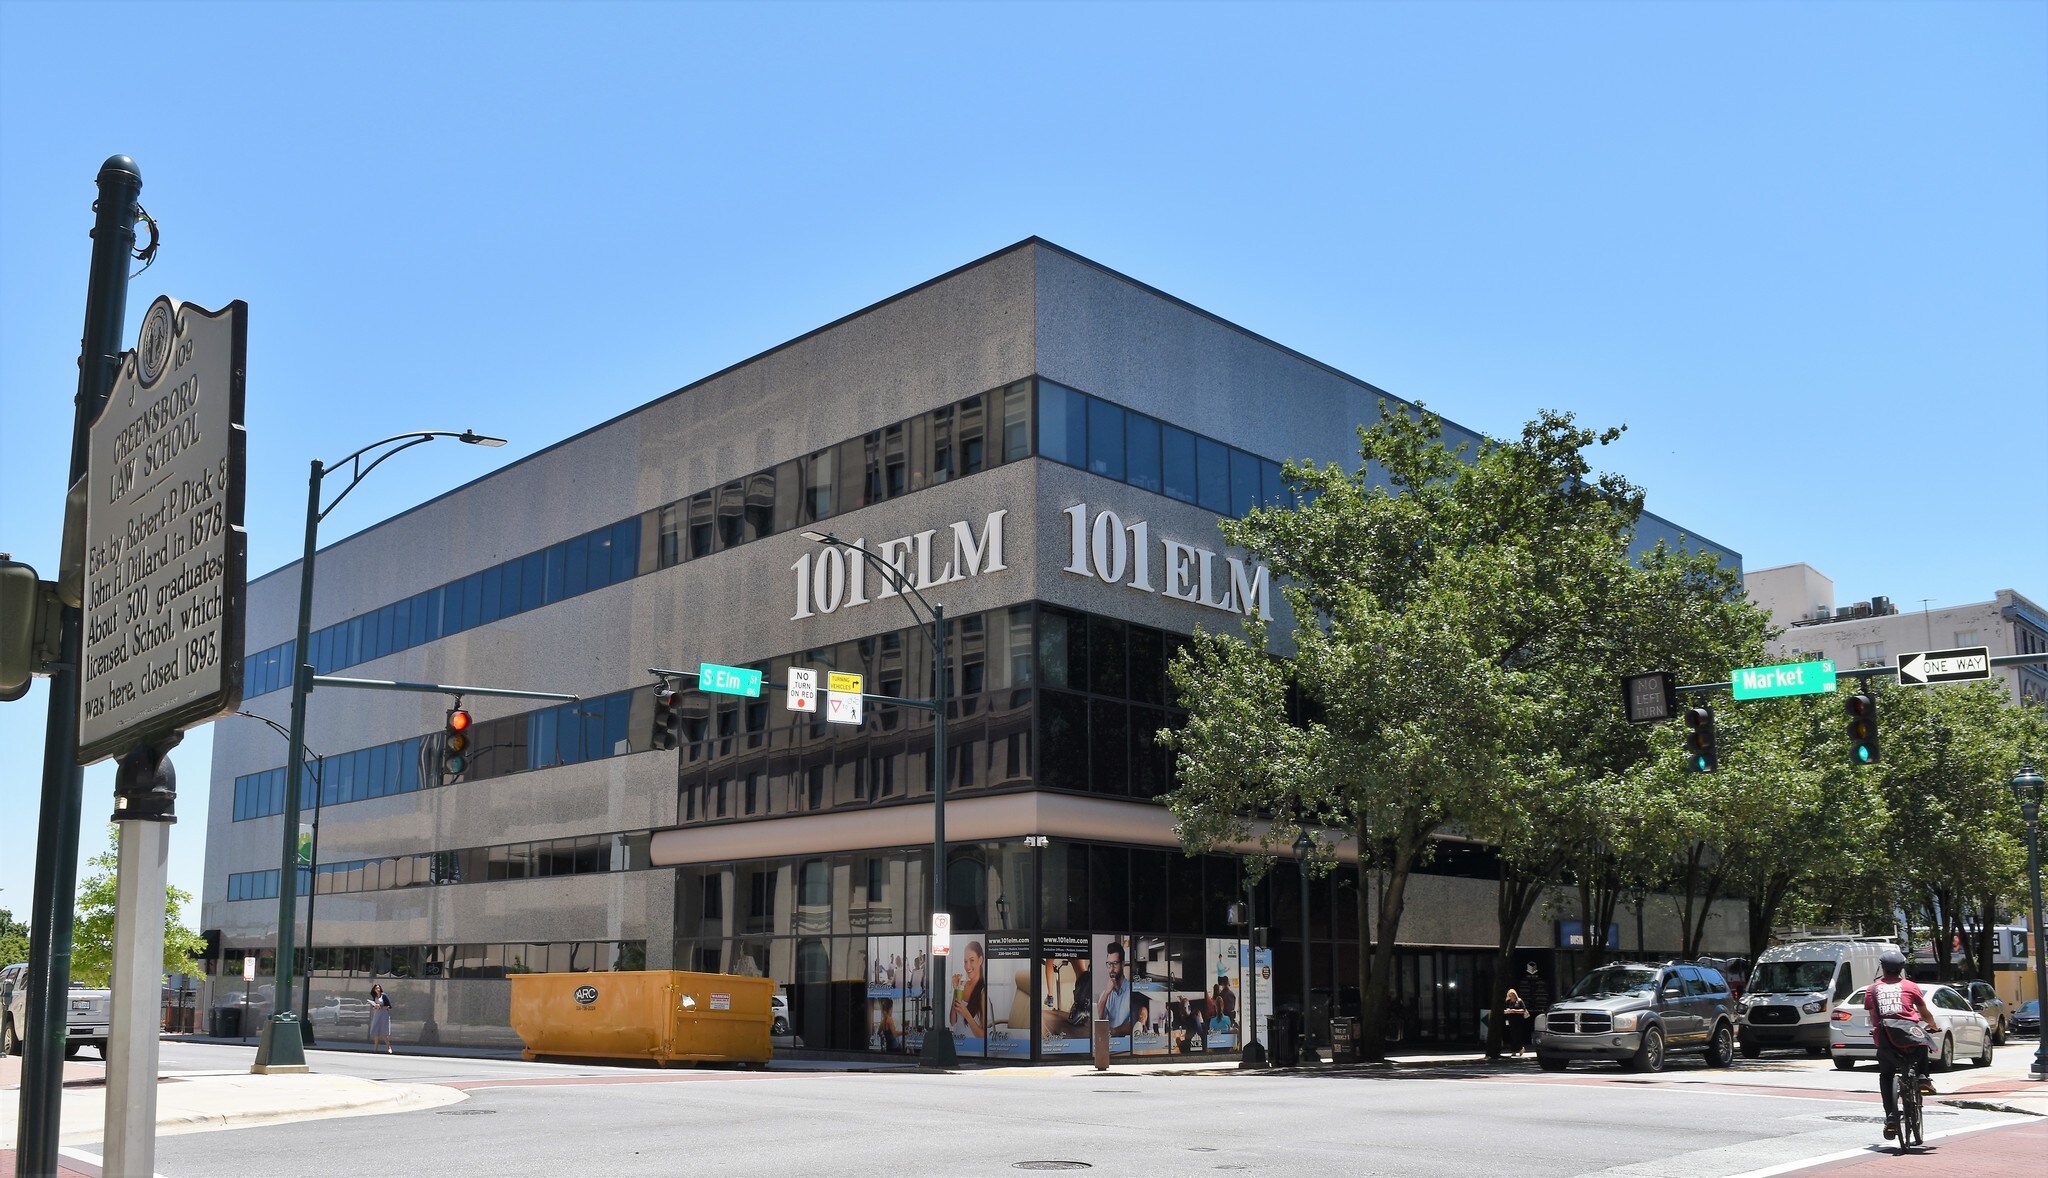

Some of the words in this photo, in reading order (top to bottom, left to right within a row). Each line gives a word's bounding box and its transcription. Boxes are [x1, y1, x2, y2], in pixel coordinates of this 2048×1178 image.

[174, 338, 194, 372] 109
[114, 374, 198, 465] GREENSBORO
[110, 458, 137, 505] LAW
[144, 412, 201, 478] SCHOOL
[89, 541, 108, 576] Est.
[110, 533, 125, 565] by
[127, 497, 167, 552] Robert
[169, 488, 178, 523] P.
[181, 468, 214, 515] Dick
[218, 456, 228, 491] &
[89, 578, 111, 611] John
[114, 562, 125, 596] H.
[126, 533, 170, 588] Dillard
[173, 532, 186, 561] in
[189, 501, 226, 551] 1878.
[790, 537, 871, 620] 101
[877, 509, 1008, 599] ELM
[1063, 503, 1155, 593] 101
[1161, 538, 1274, 622] ELM
[87, 604, 119, 649] About
[125, 584, 149, 624] 300
[156, 551, 224, 615] graduates
[86, 632, 130, 682] licensed.
[181, 585, 223, 633] which
[85, 695, 105, 721] was
[109, 680, 136, 711] here,
[141, 647, 181, 695] closed
[185, 630, 220, 677] 1893.
[796, 672, 809, 681] NO
[1732, 672, 1740, 683] E
[1743, 667, 1805, 690] Market
[1822, 663, 1833, 672] St
[1924, 660, 1948, 673] ONE
[1956, 658, 1982, 670] WAY
[703, 669, 712, 685] S
[716, 670, 741, 690] Elm
[750, 675, 758, 684] St
[795, 682, 811, 690] TURN
[830, 683, 851, 691] VEHICLES
[1637, 678, 1658, 691] NO
[1823, 682, 1835, 691] 100
[801, 691, 814, 699] RED
[1636, 692, 1662, 705] LEFT
[1636, 705, 1663, 717] TURN
[576, 988, 595, 1000] ARC
